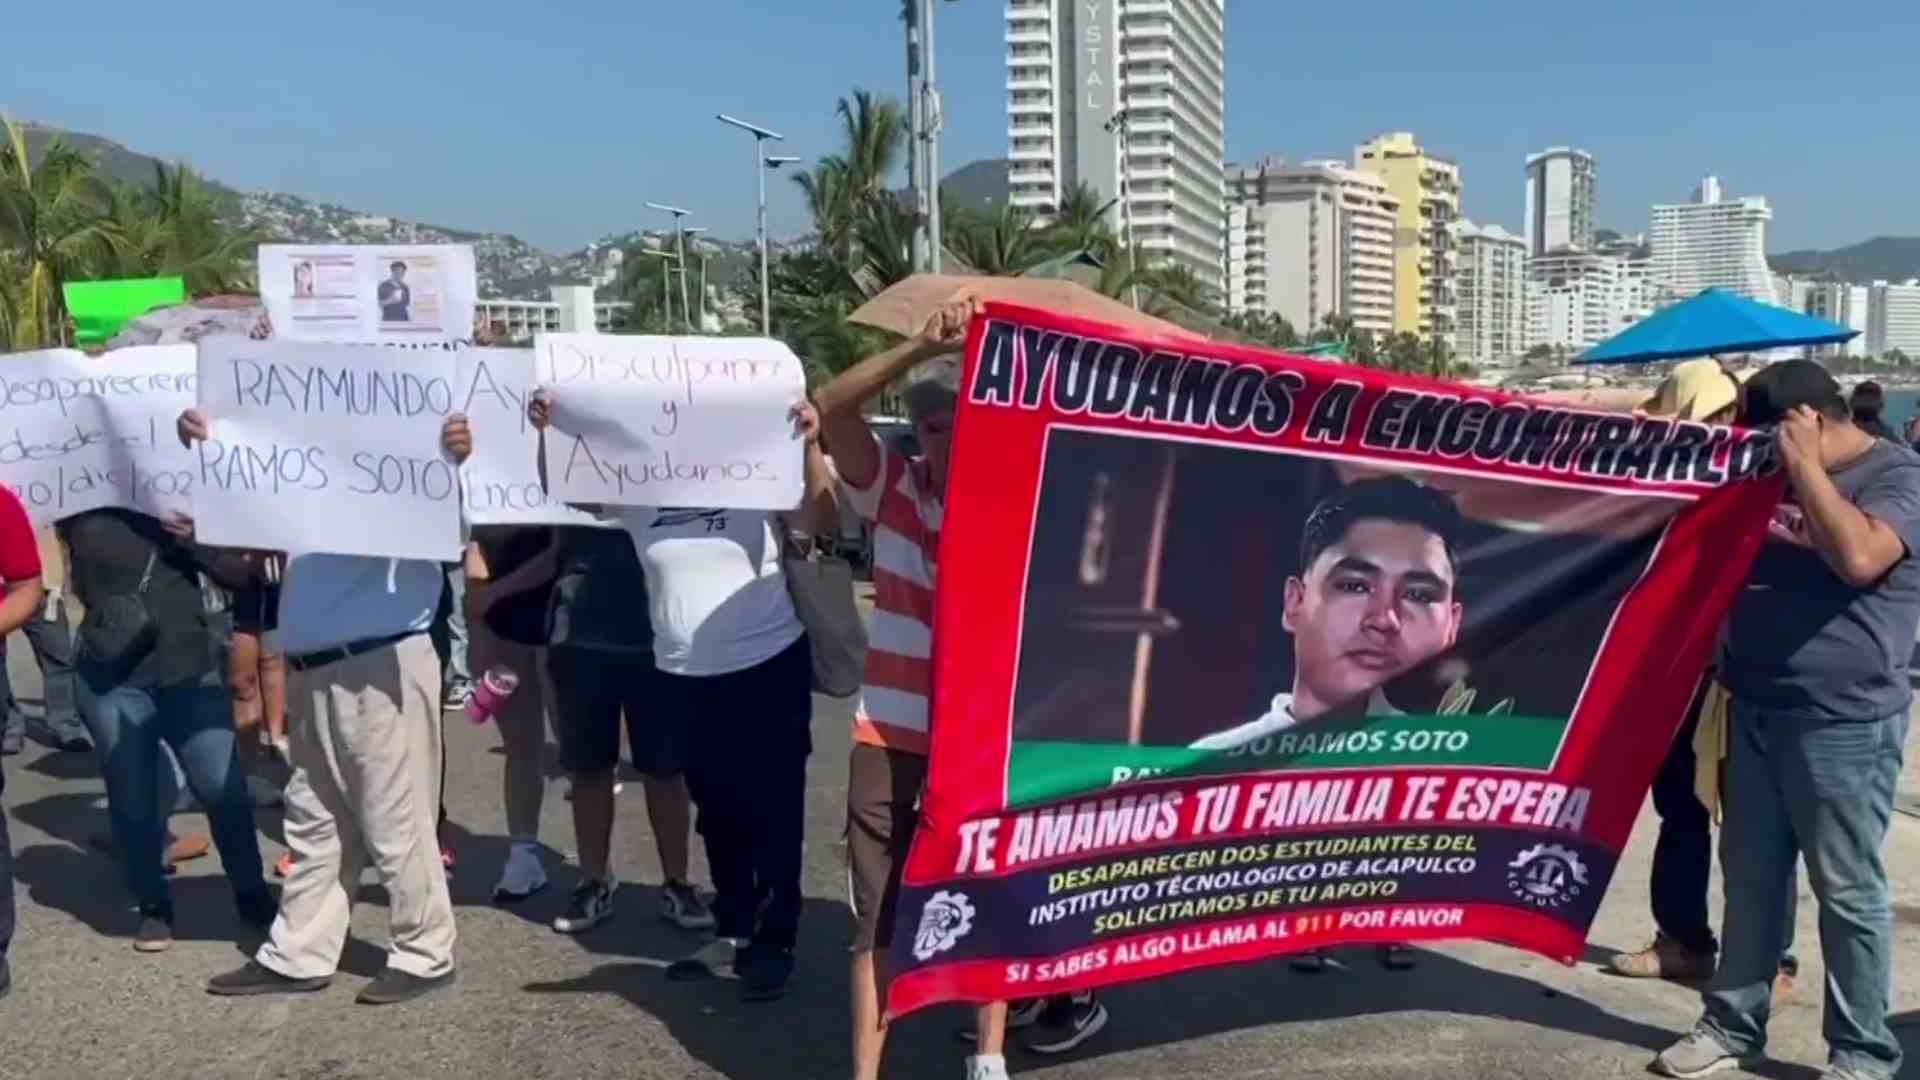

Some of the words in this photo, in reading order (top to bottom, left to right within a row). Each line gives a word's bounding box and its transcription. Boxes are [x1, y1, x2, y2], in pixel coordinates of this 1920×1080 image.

[232, 358, 452, 417] RAYMUNDO
[969, 319, 1306, 437] AYUDANOS
[1302, 379, 1363, 444] A
[651, 399, 678, 437] y
[200, 438, 328, 496] RAMOS
[348, 450, 454, 501] SOTO
[565, 433, 779, 496] Ayudanos
[704, 517, 726, 532] 73
[1277, 730, 1385, 755] RAMOS
[1391, 729, 1470, 753] SOTO
[954, 818, 1001, 874] TE
[1006, 790, 1183, 867] AMAMOS
[1190, 784, 1241, 836] TU
[1243, 776, 1393, 831] FAMILIA
[1399, 776, 1441, 822] TE
[1445, 776, 1592, 832] ESPERA
[1029, 883, 1149, 926] INSTITUTO
[1321, 861, 1351, 878] DE
[1356, 856, 1477, 876] ACAPULCO
[1048, 849, 1216, 895] DESAPARECEN
[1221, 842, 1270, 866] DOS
[1273, 835, 1427, 861] ESTUDIANTES
[1433, 834, 1477, 853] DEL
[1093, 892, 1248, 935] SOLICITAMOS
[1252, 888, 1283, 908] DE
[1287, 886, 1318, 904] TU
[1323, 879, 1399, 900] APOYO
[1006, 963, 1030, 983] SI
[1036, 948, 1108, 982] SABES
[1113, 936, 1177, 965] ALGO
[1182, 921, 1257, 954] LLAMA
[1261, 917, 1290, 938] AL
[1295, 914, 1333, 935] 911
[1339, 908, 1386, 929] POR
[1390, 907, 1465, 928] FAVOR
